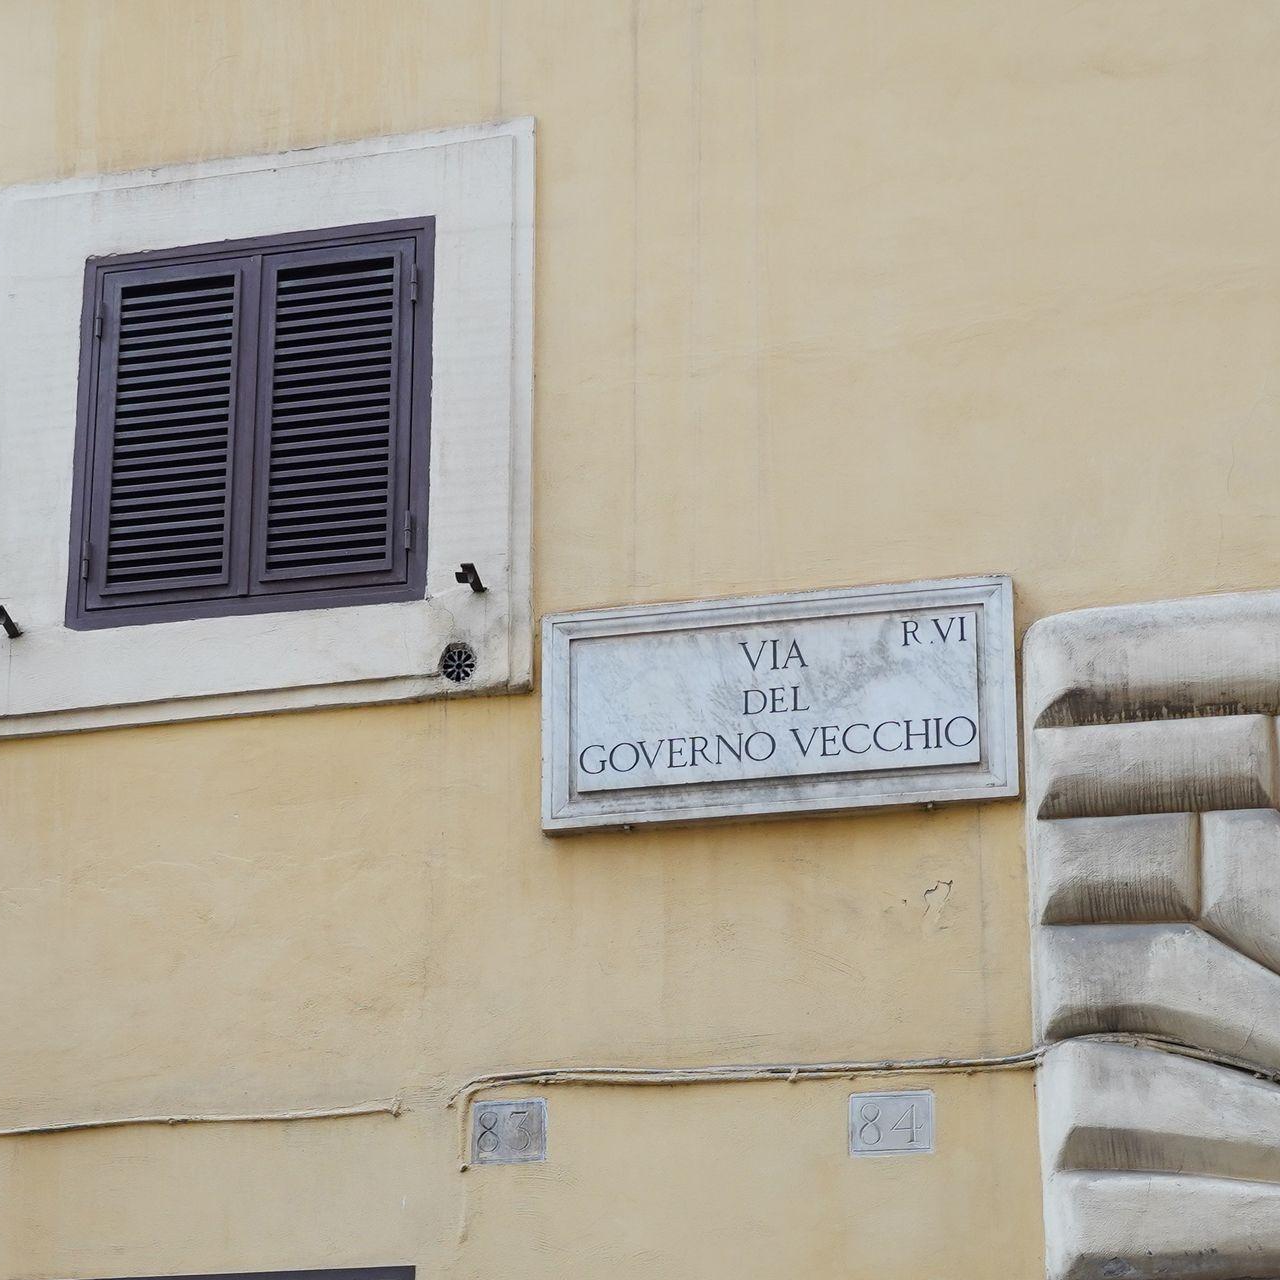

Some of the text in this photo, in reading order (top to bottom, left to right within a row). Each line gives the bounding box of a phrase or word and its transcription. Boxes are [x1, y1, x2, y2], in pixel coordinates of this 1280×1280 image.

[738, 638, 809, 672] VIA
[742, 684, 810, 716] DEL
[579, 715, 977, 775] GOVERNO VECCHIO
[477, 1110, 532, 1153] 83
[860, 1102, 927, 1146] 84
